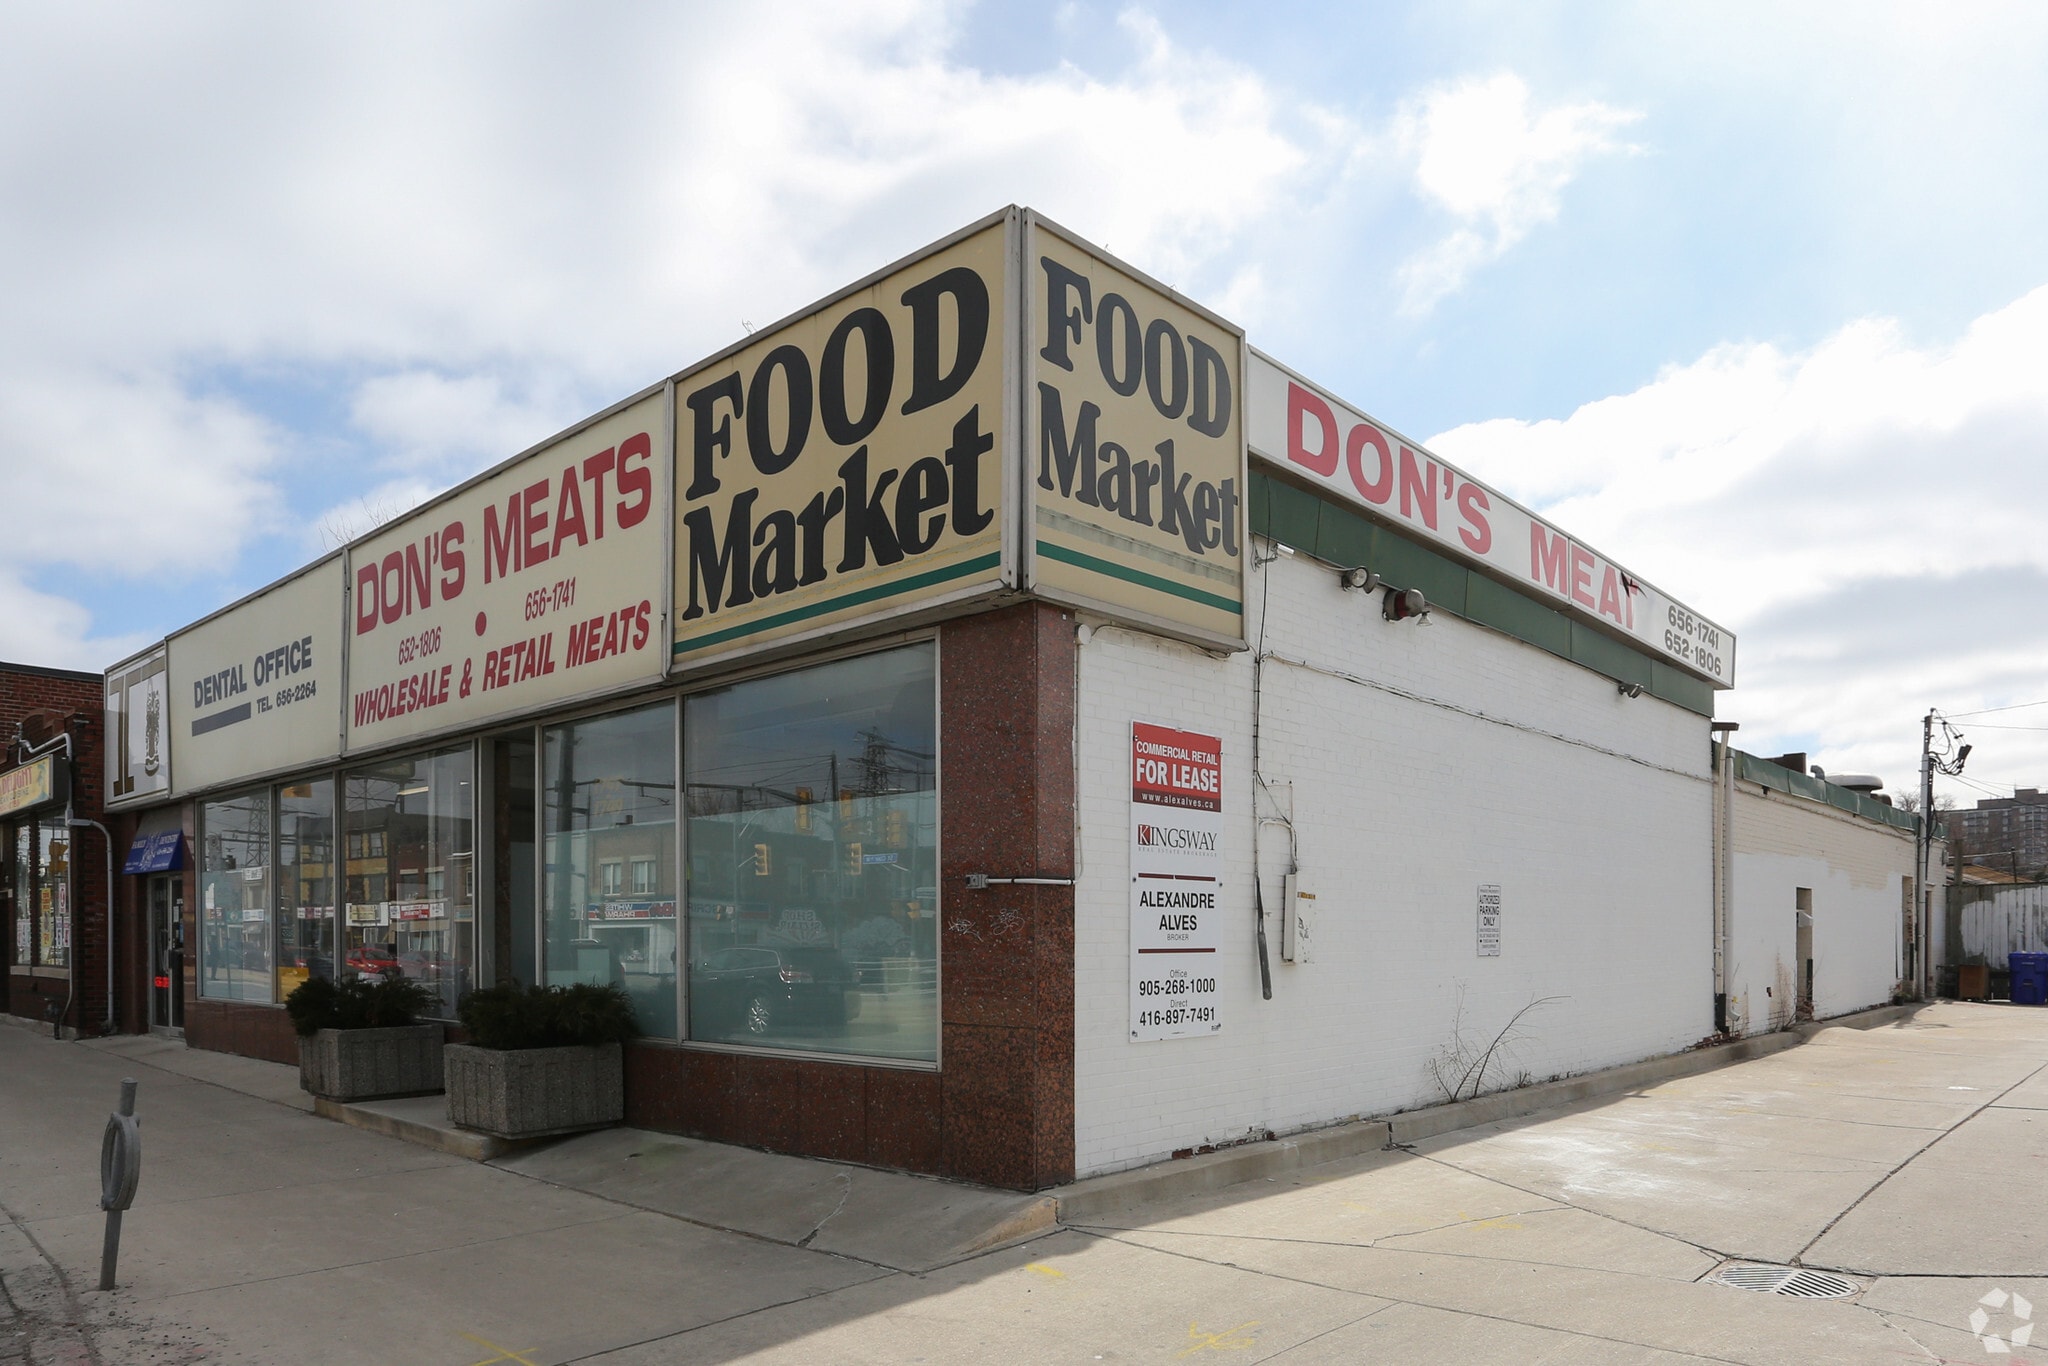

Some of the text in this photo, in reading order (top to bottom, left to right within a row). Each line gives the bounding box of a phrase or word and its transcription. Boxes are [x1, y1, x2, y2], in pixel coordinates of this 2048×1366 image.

[1040, 256, 1232, 438] FOOD
[686, 266, 990, 501] FOOD
[1037, 381, 1239, 556] Market
[1287, 381, 1492, 555] DON'S
[682, 403, 994, 621] Market
[357, 432, 651, 636] DON'S MEATS
[525, 576, 576, 621] 656-1741
[398, 626, 442, 666] 652-1806
[194, 635, 312, 708] DENTAL OFFICE
[354, 600, 651, 727] WHOLESALE & RETAIL MEATS
[276, 680, 317, 707] 656-2264
[1136, 741, 1218, 765] COMMERCIAL RETAIL
[1136, 758, 1218, 797] FOR LEASE
[1142, 793, 1214, 809] www.alexalves.ca
[1138, 824, 1218, 851] KINGSWAY
[1140, 891, 1215, 909] ALEXANDRE
[1479, 905, 1500, 915] PARKING
[1159, 914, 1197, 931] ALVES
[1483, 916, 1496, 926] ONLY
[1167, 933, 1189, 941] BROKER
[1139, 978, 1216, 996] 905-268-1000
[1170, 969, 1188, 978] Office
[1140, 1007, 1215, 1026] 416-897-7491
[1170, 1000, 1188, 1008] Direct
